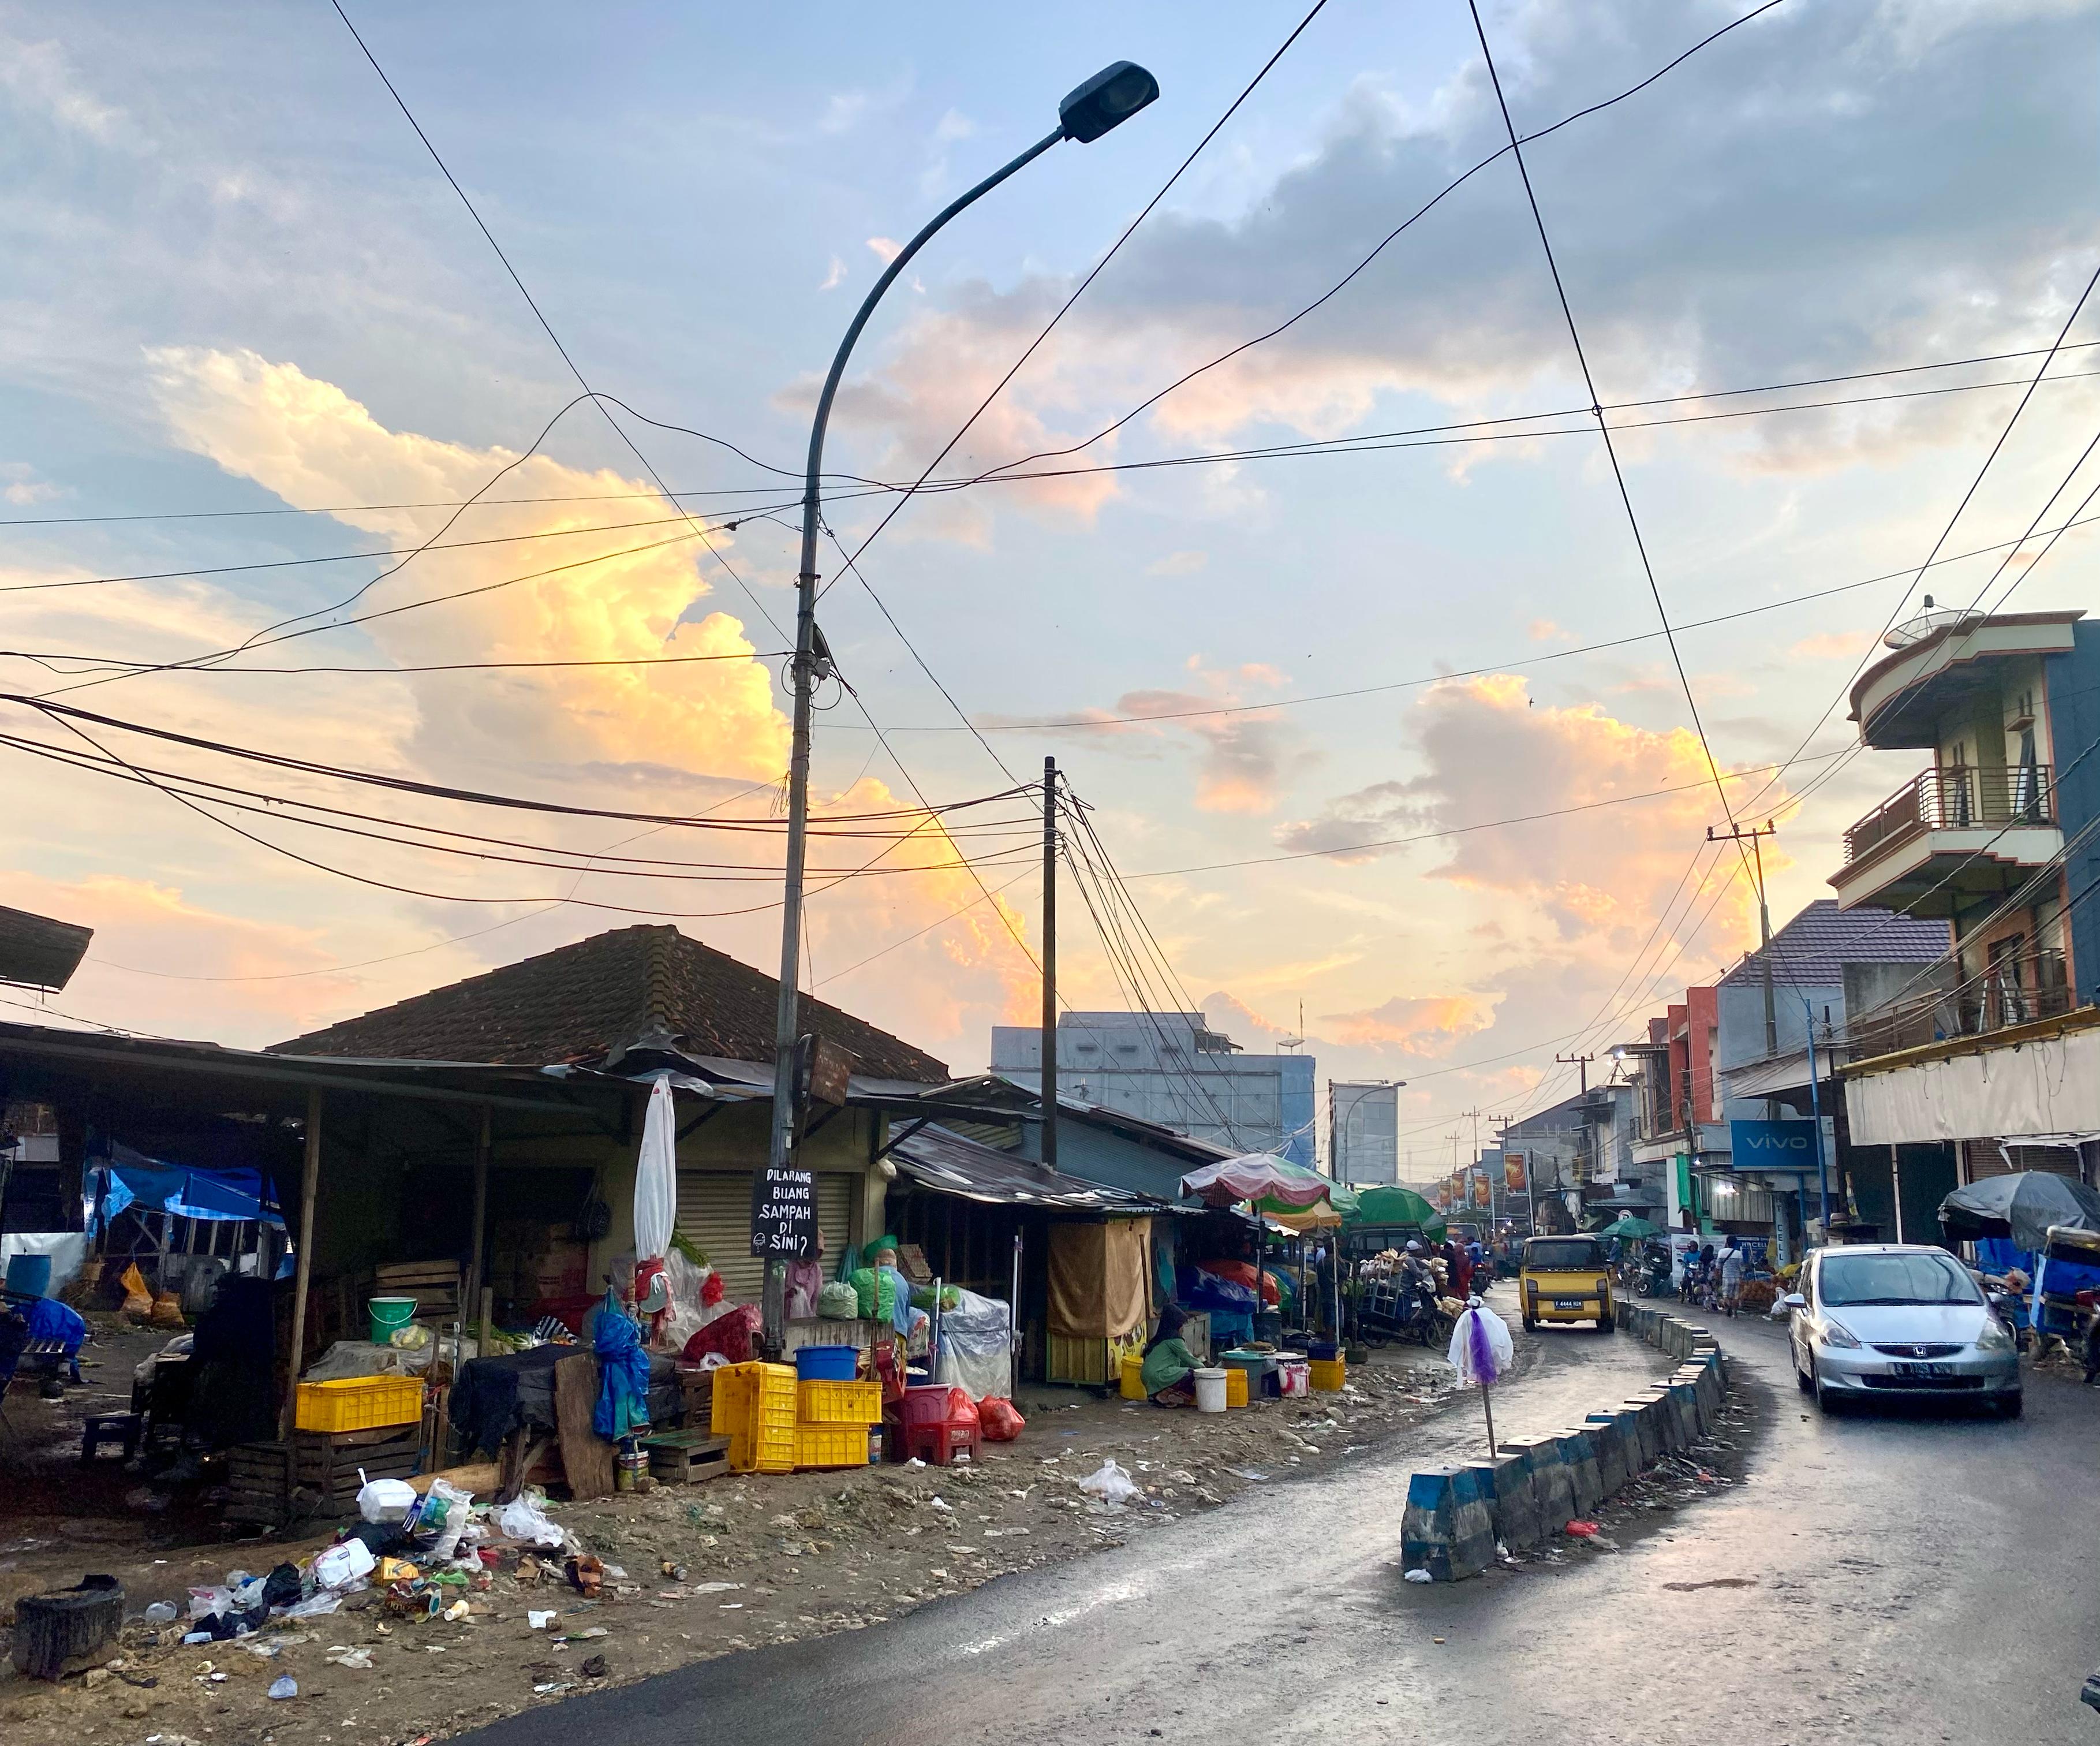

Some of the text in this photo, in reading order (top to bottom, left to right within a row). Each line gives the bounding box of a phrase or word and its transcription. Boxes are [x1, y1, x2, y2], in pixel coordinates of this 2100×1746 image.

[1746, 1133, 1807, 1149] vivo
[767, 1169, 812, 1184] DILARANG
[773, 1187, 809, 1200] BUANG
[758, 1204, 810, 1220] SAMPAH
